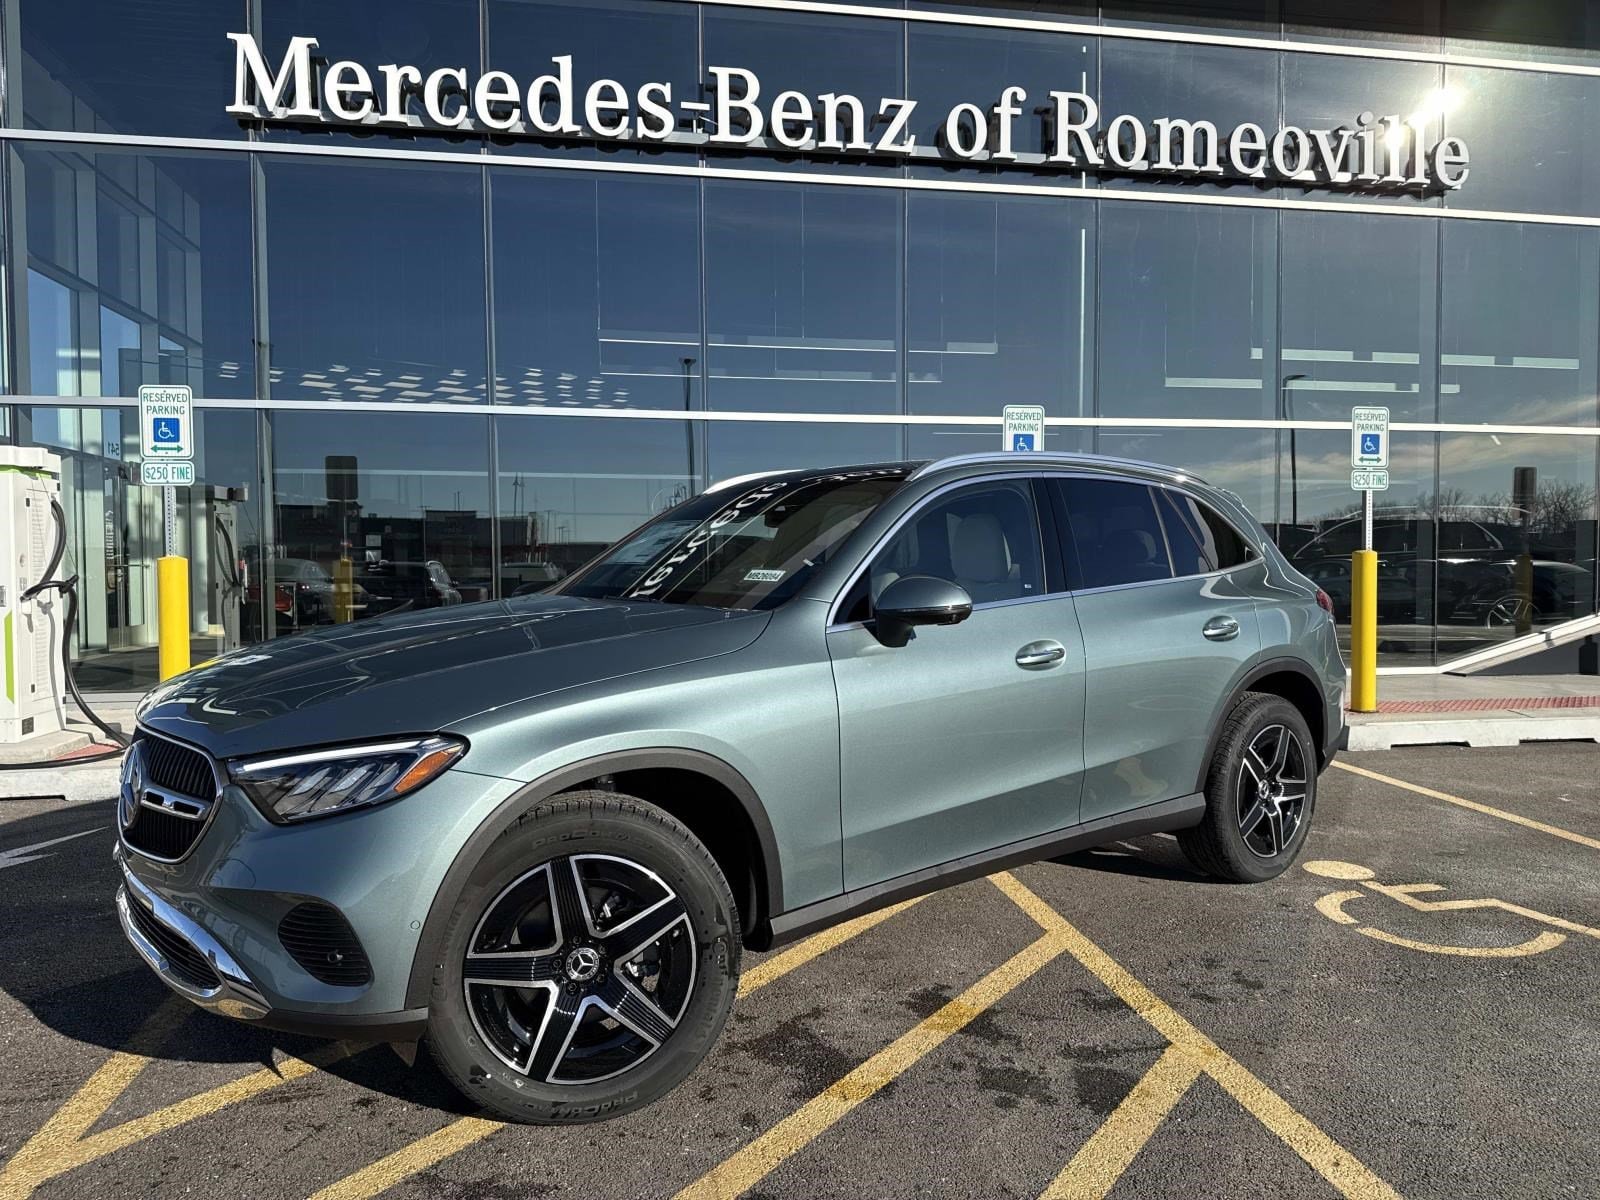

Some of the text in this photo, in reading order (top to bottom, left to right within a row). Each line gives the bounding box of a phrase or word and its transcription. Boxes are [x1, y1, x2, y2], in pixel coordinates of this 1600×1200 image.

[225, 32, 1471, 190] Mercedes-Benz of Romeoville
[143, 392, 188, 403] RESERVED
[146, 405, 186, 415] PARKING
[1006, 411, 1042, 421] RESERVED
[1355, 413, 1386, 421] RESERVED
[1008, 422, 1039, 432] PARKING
[145, 466, 191, 481] $250 FINE
[1354, 474, 1386, 486] $250 FINE
